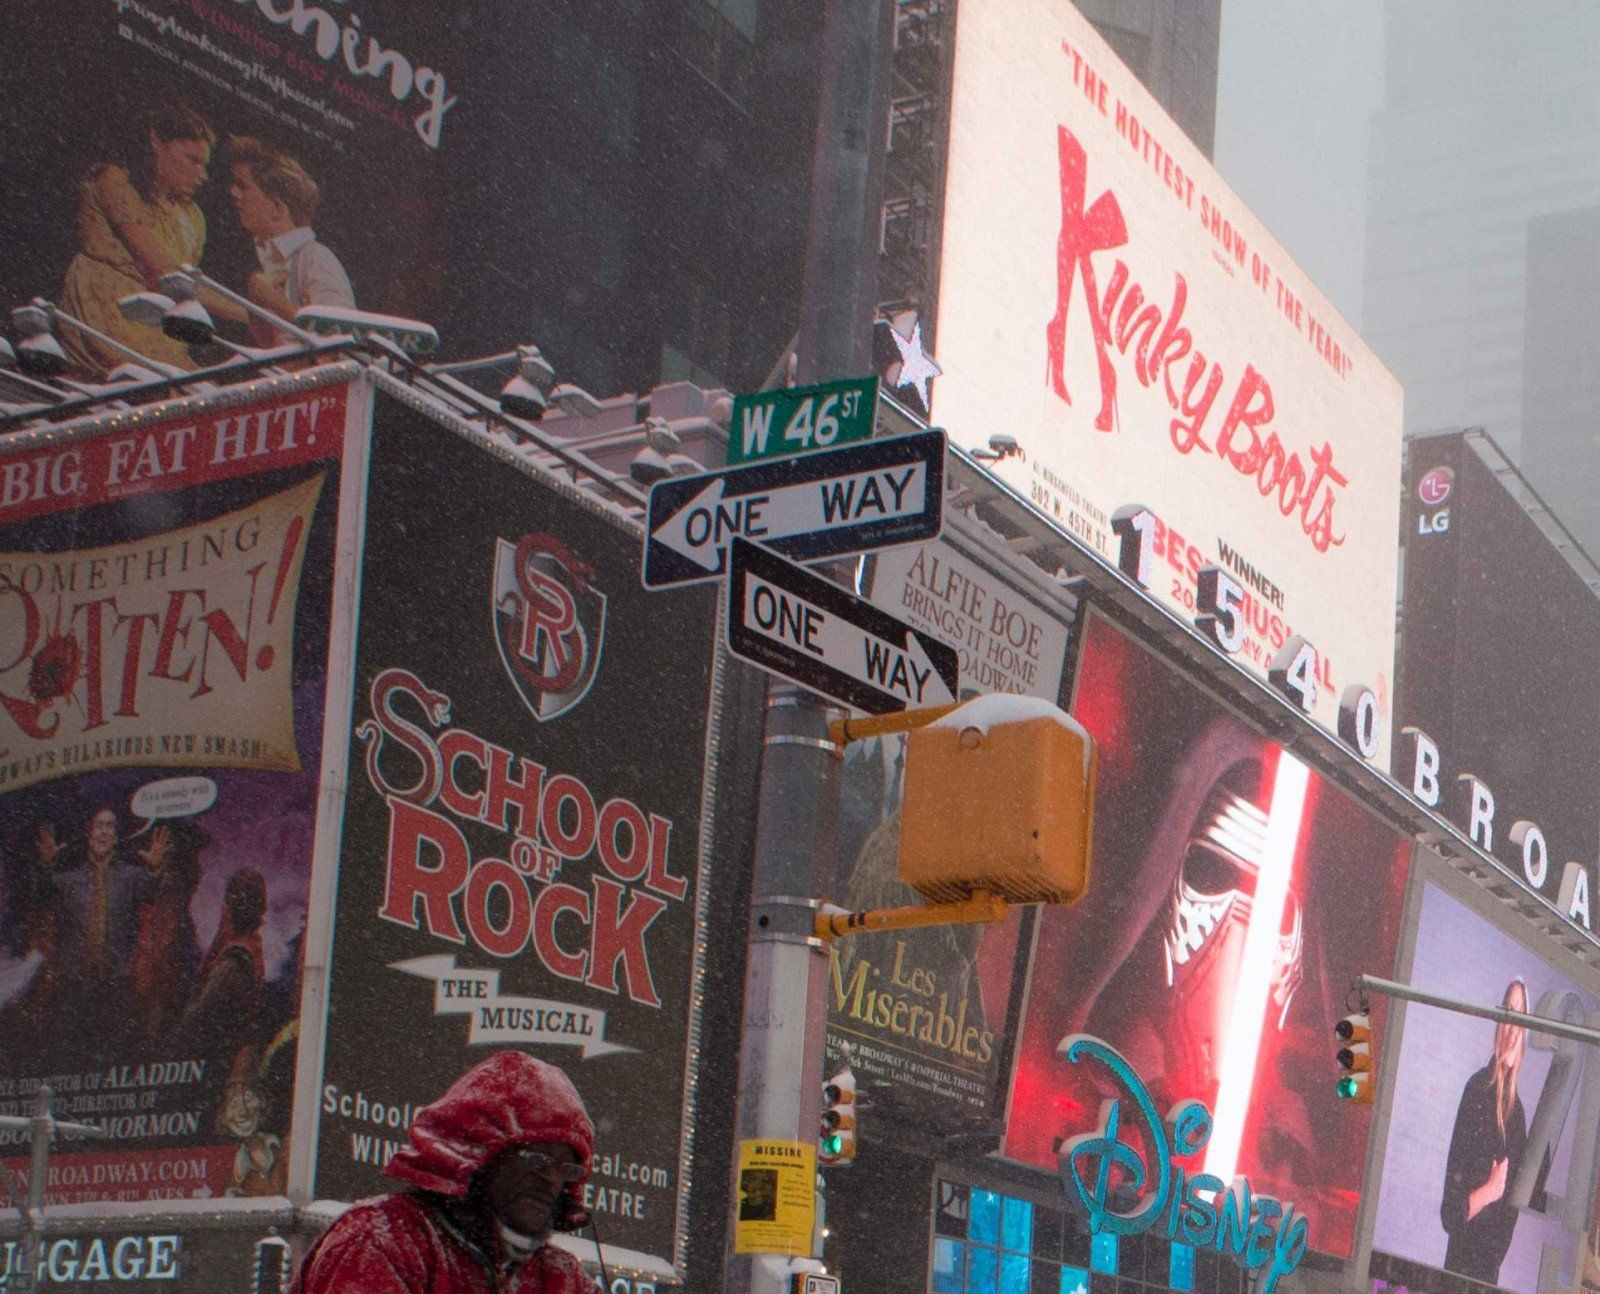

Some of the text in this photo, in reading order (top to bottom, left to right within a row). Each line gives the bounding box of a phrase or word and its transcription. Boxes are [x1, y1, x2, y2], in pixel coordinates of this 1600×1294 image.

[1116, 99, 1195, 210] HOTTEST
[1200, 194, 1247, 269] SHOW
[1251, 252, 1271, 294] OF
[1276, 278, 1303, 333] THE
[1046, 123, 1347, 554] Kinky Boots
[104, 426, 197, 486] FAT
[743, 390, 863, 457] W 46 ST
[685, 468, 916, 547] ONE WAY
[1069, 511, 1092, 542] 45TH
[1419, 510, 1450, 534] LG
[1155, 515, 1213, 587] BES
[1218, 538, 1285, 612] WINNER!
[901, 583, 965, 642] BRINGS
[966, 627, 985, 654] IT
[988, 635, 1038, 687] HOME
[906, 548, 1043, 661] ALFIE BOE
[753, 584, 824, 656] ONE
[863, 636, 931, 703] WAY
[510, 840, 561, 883] OF
[379, 795, 667, 1008] ROCK
[442, 979, 488, 999] THE
[892, 940, 936, 998] Les
[480, 1006, 594, 1036] MUSICAL
[829, 945, 995, 1063] Misérables
[103, 1060, 208, 1088] ALADDIN
[102, 1111, 201, 1139] MORMON
